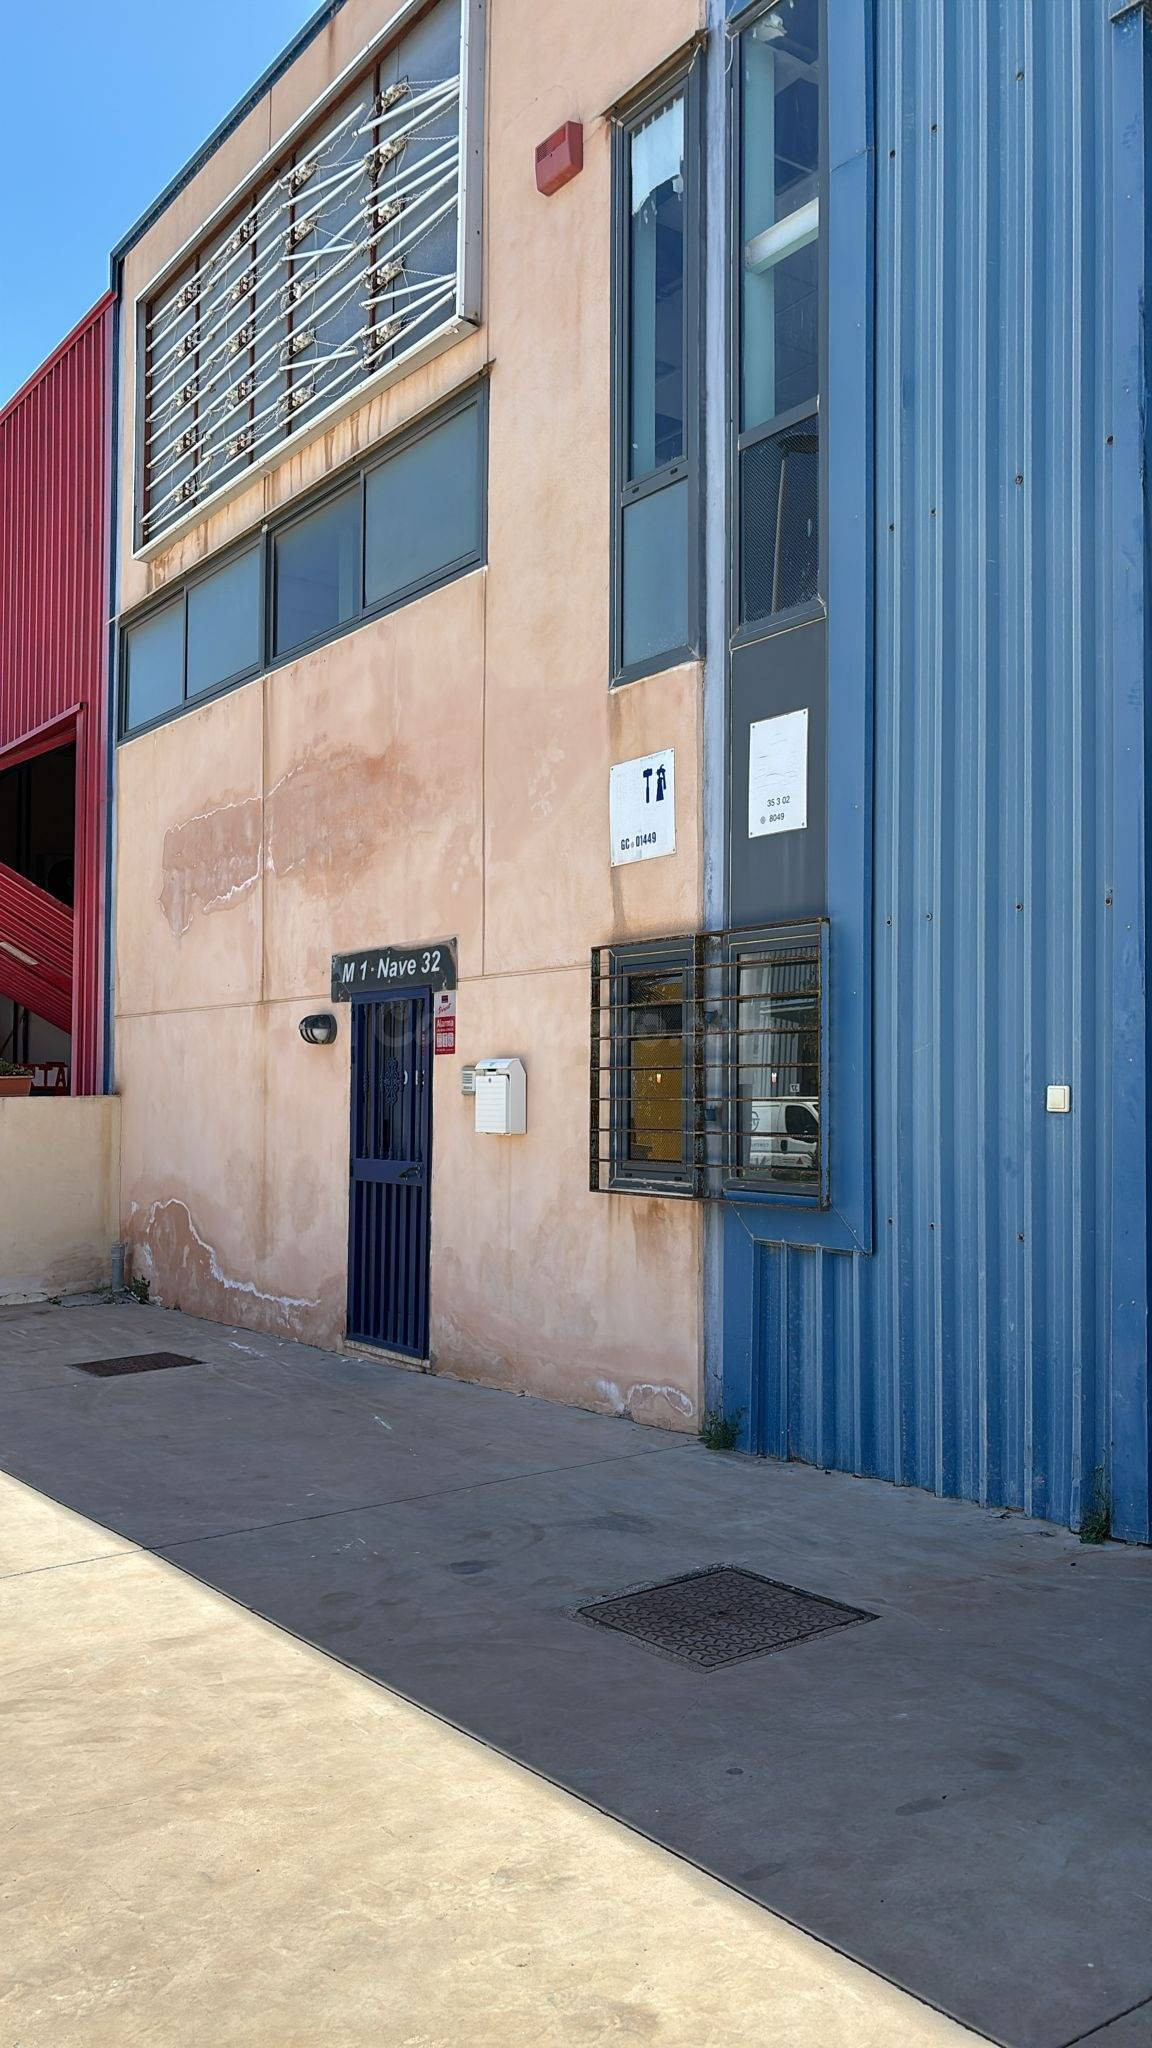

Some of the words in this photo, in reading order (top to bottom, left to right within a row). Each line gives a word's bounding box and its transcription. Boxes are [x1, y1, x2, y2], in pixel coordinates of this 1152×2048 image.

[620, 838, 630, 850] GC
[636, 831, 656, 847] 01449
[342, 962, 355, 983] M
[377, 957, 417, 979] Nave
[421, 950, 441, 974] 32
